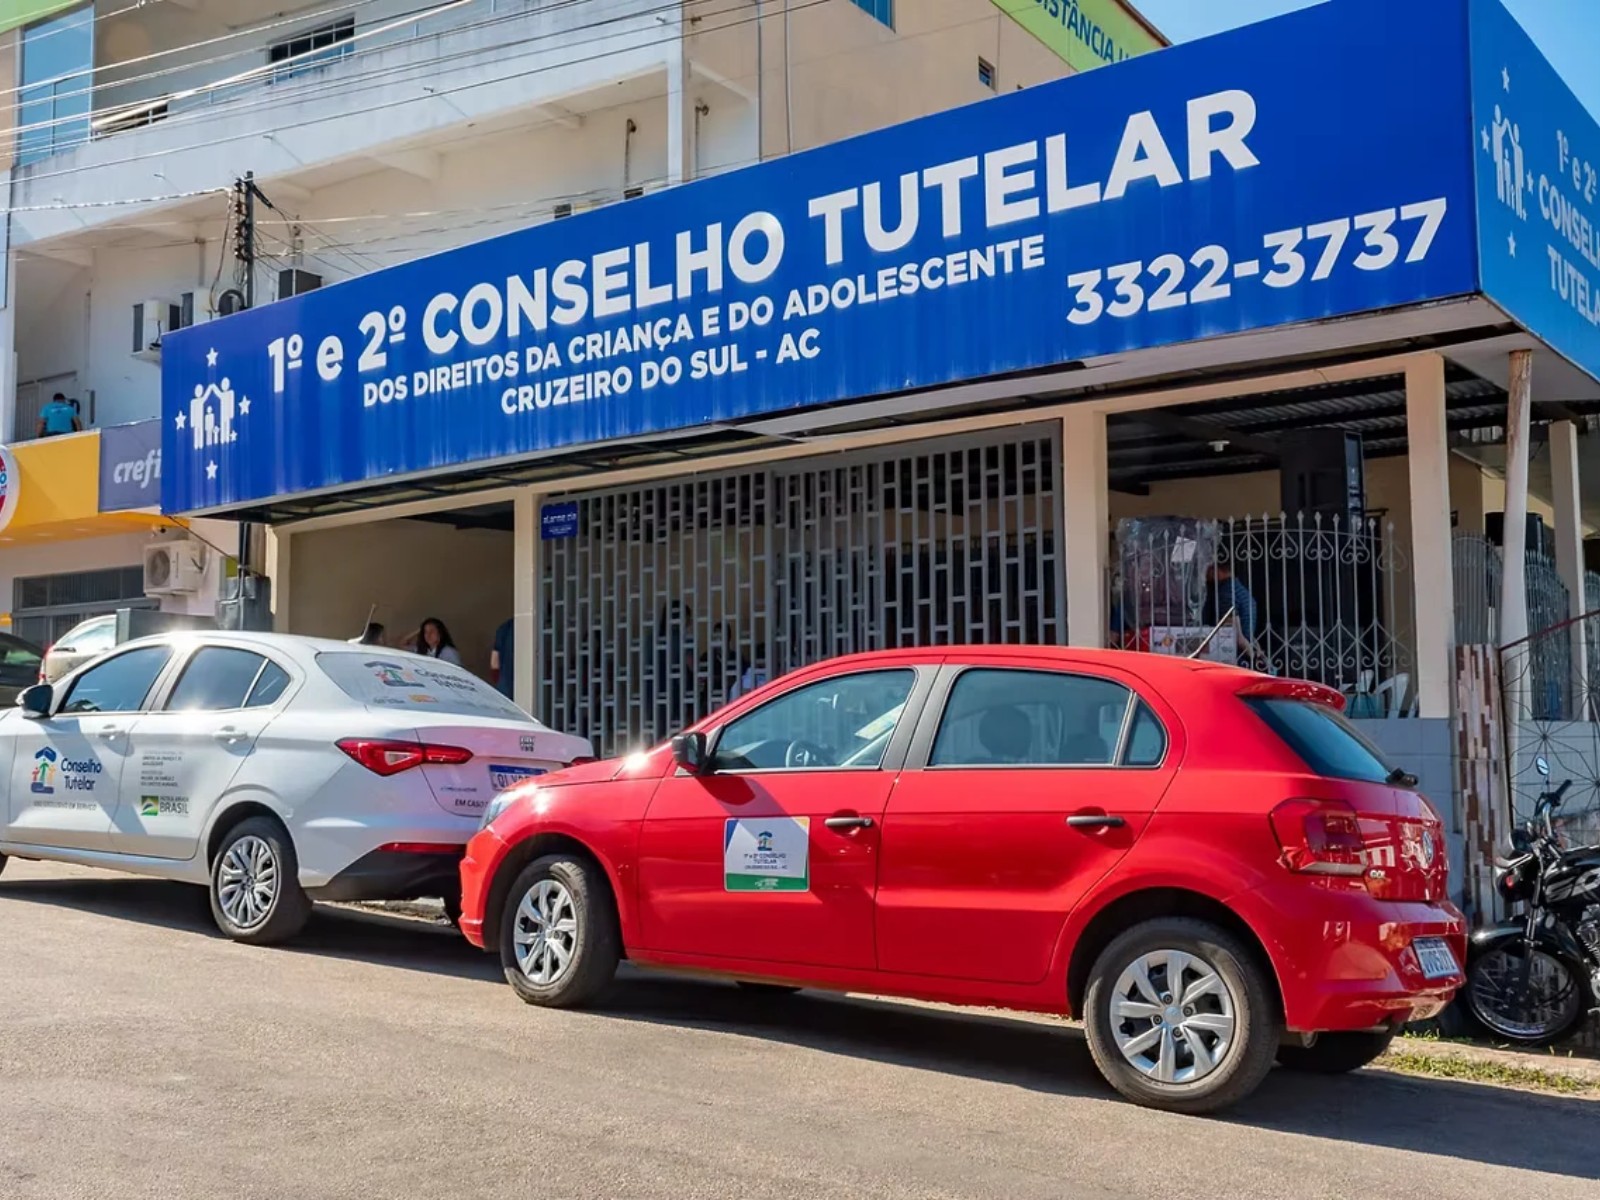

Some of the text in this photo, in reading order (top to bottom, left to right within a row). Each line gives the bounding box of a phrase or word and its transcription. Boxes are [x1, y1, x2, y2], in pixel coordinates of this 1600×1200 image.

[1034, 0, 1115, 63] STÂNCIA
[1572, 156, 1581, 191] e
[267, 89, 1261, 393] 1º e 2º CONSELHO TUTELAR
[1066, 197, 1447, 325] 3322-3737
[363, 234, 1045, 408] DOS DIREITOS DA CRIANÇA E DO ADOLESCENTE
[501, 365, 633, 415] CRUZEIRO
[640, 356, 683, 390] DO
[690, 344, 748, 379] SUL
[775, 328, 821, 364] AC
[61, 757, 102, 774] Conselho
[64, 775, 96, 791] Tutelar
[159, 801, 189, 814] BRASIL
[455, 798, 466, 807] EM
